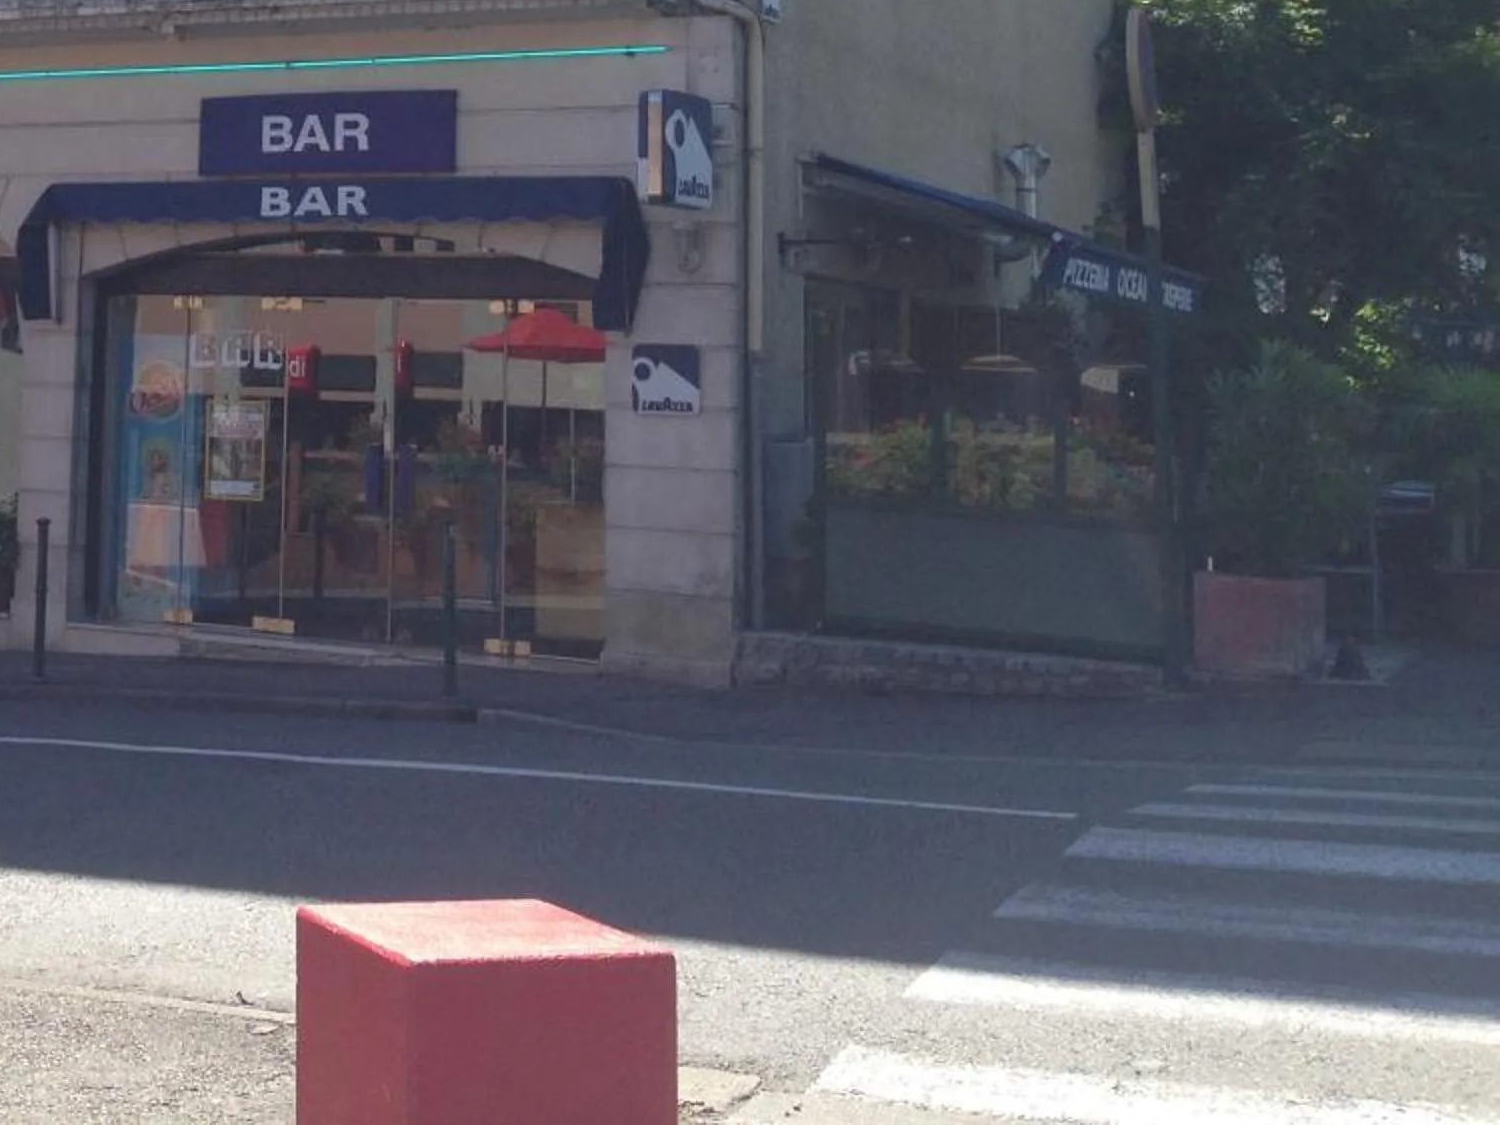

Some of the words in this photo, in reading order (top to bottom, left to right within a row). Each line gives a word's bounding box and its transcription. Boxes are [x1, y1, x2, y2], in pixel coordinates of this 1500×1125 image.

[261, 112, 370, 153] BAR
[260, 184, 369, 217] BAR
[641, 396, 693, 412] LAVAZZA
